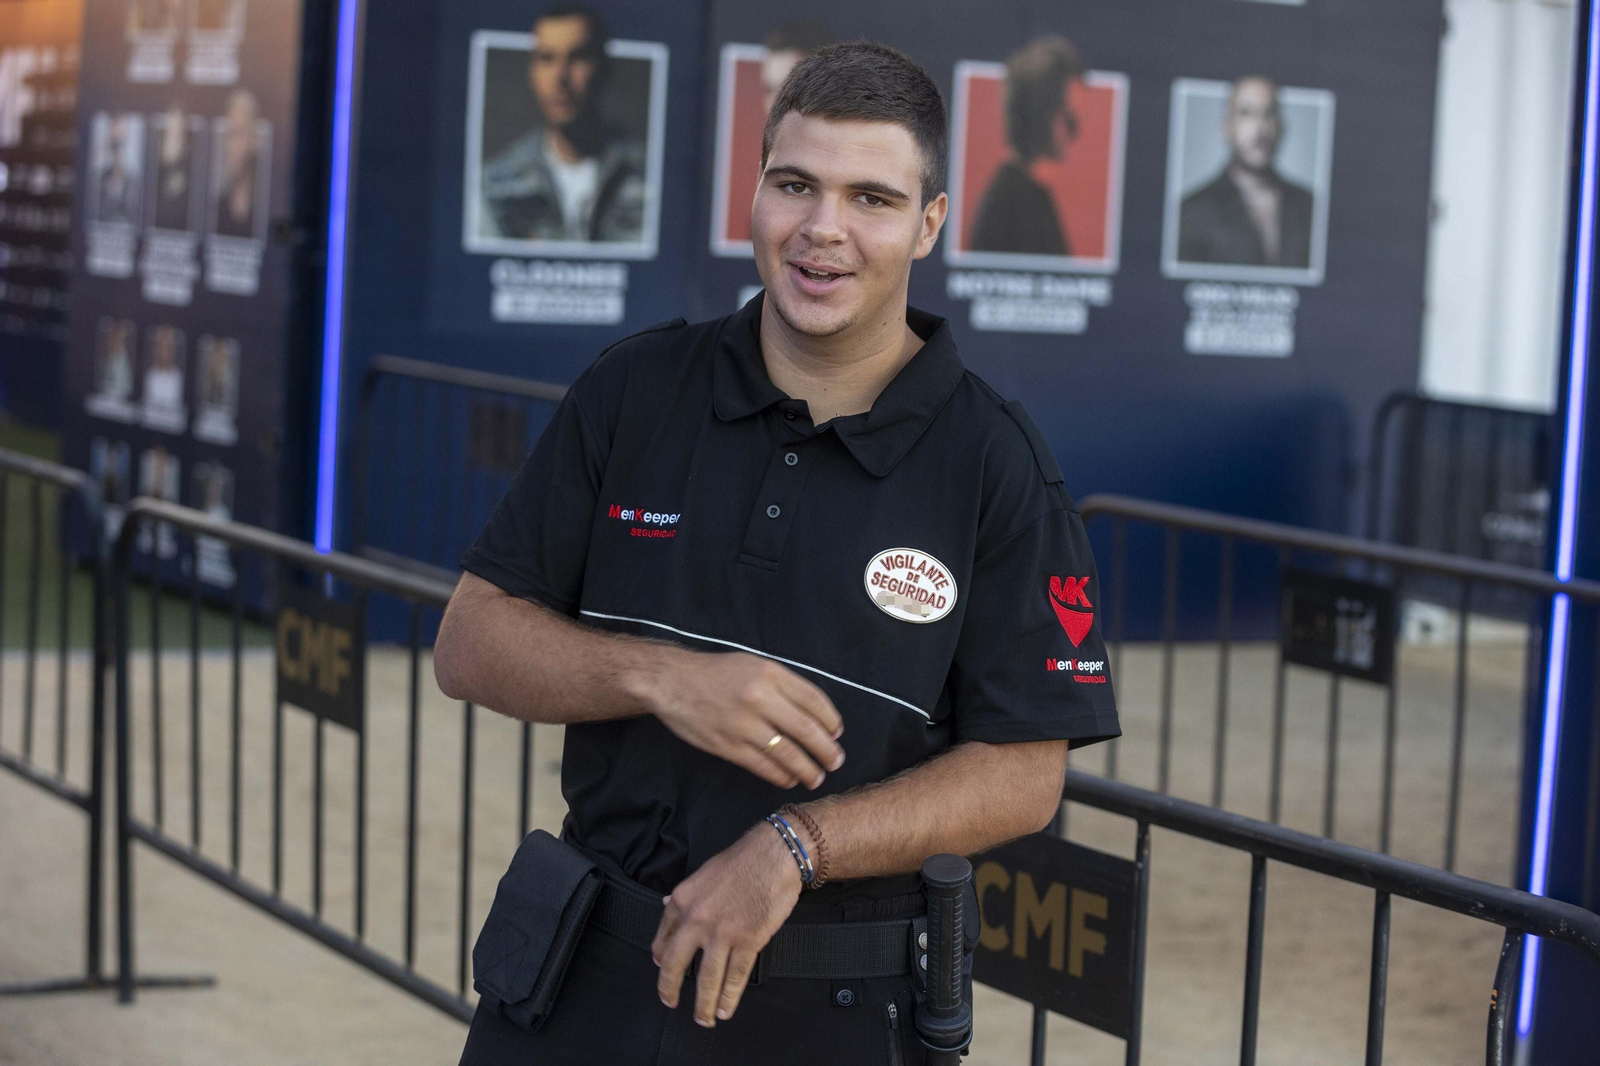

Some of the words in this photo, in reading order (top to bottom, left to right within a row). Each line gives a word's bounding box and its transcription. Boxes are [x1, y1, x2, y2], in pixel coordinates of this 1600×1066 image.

[608, 504, 681, 526] MenKeeper
[879, 554, 949, 591] VIGILANTE
[906, 571, 920, 584] DE
[871, 571, 947, 610] SEGURIDAD
[1049, 576, 1093, 608] MK
[278, 609, 352, 694] CMF
[1046, 658, 1104, 673] MenKeeper
[976, 861, 1109, 978] CMF
